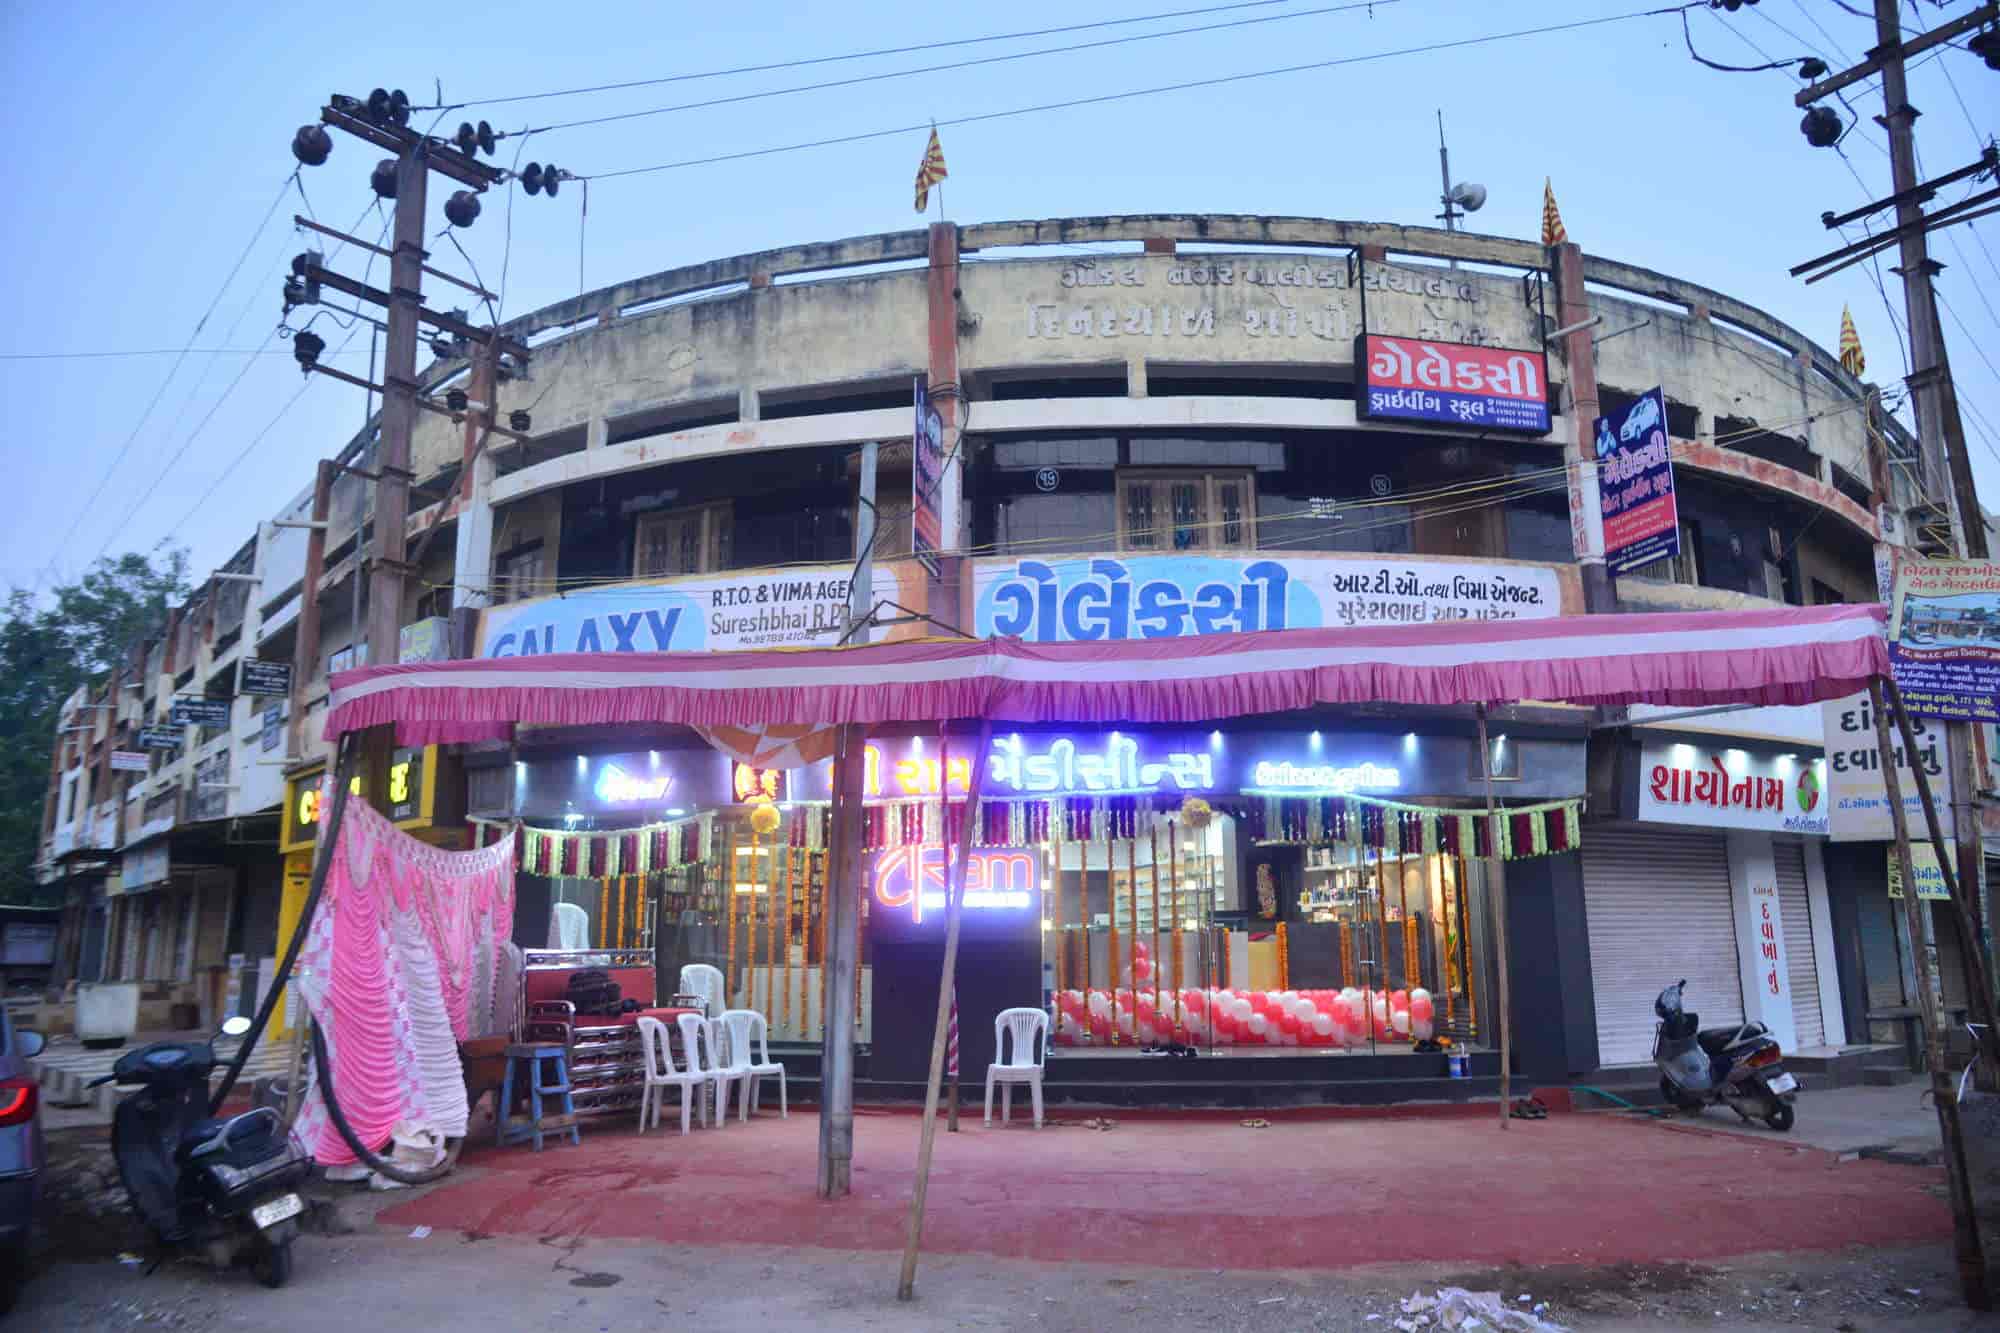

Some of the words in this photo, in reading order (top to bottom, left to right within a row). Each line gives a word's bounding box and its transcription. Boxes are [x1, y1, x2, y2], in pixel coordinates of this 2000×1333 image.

[712, 583, 753, 608] R.T.O.
[755, 584, 769, 603] &
[772, 581, 813, 602] VIMA
[1453, 575, 1488, 601] વિમા
[711, 605, 808, 636] Sureshbhai
